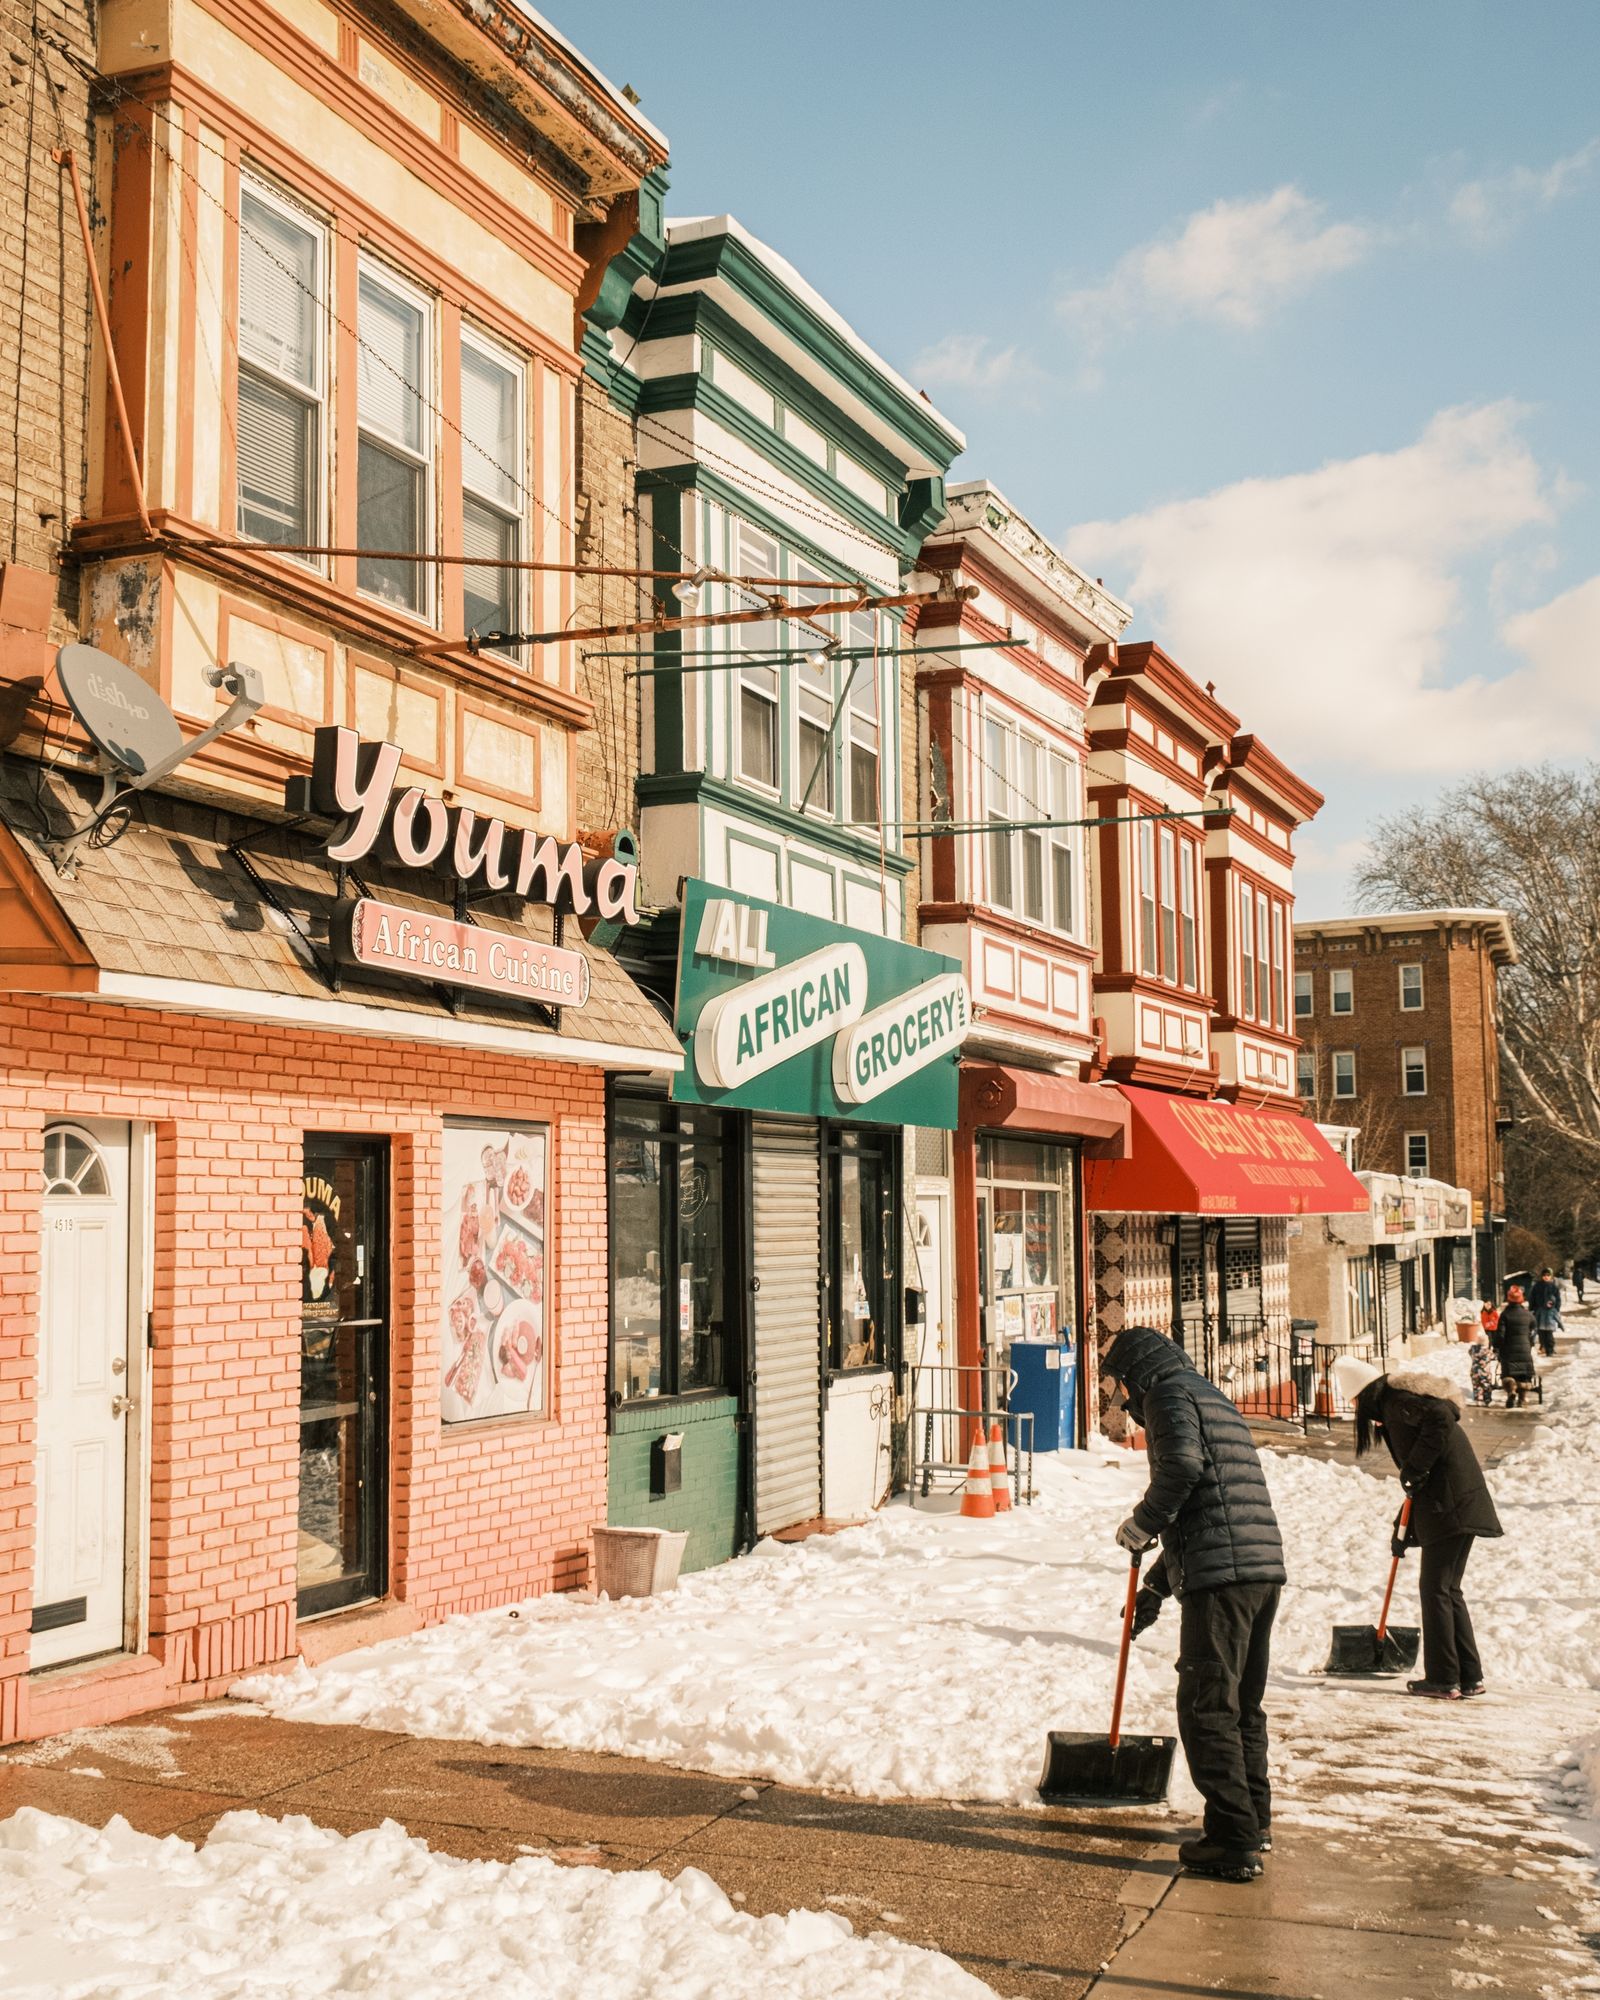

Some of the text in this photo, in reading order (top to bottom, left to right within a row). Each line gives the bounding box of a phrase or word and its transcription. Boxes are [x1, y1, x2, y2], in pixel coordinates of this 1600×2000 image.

[87, 673, 128, 710] dish
[326, 724, 641, 927] Youma
[371, 914, 575, 996] African Cuisine
[706, 899, 776, 969] ALL
[736, 962, 852, 1067] AFRICAN
[855, 989, 957, 1087] GROCERY
[958, 986, 967, 1027] INC
[1168, 1099, 1325, 1162] QUEEN OF SHEBA
